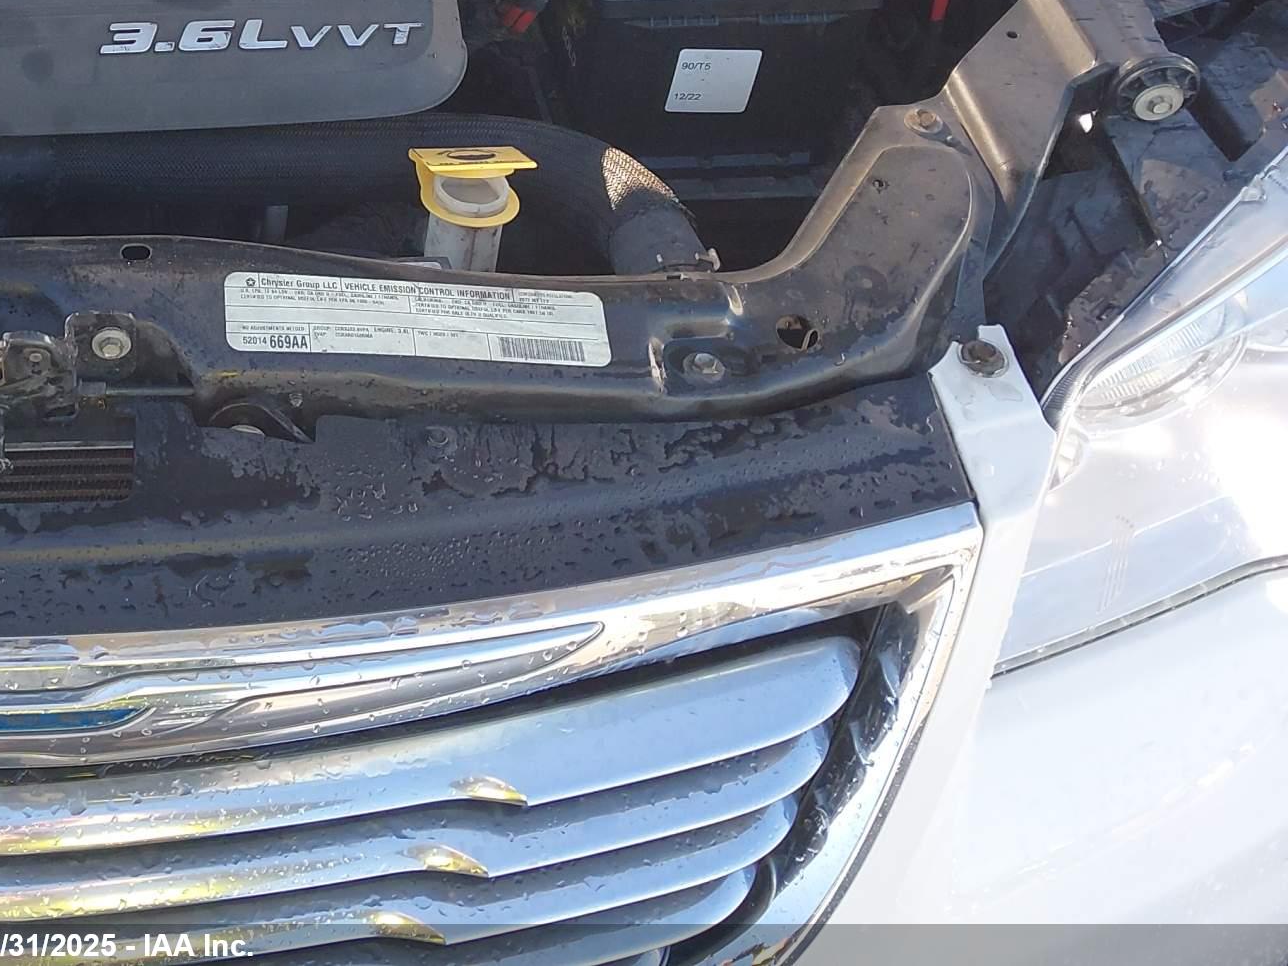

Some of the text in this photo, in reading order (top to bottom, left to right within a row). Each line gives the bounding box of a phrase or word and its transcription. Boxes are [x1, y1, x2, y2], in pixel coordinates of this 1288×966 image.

[681, 62, 711, 70] 90/T5
[674, 93, 702, 101] 12/22
[261, 277, 338, 290] Chrysler Group LLC
[344, 282, 376, 292] VEHICLE
[378, 283, 416, 294] EMISSION
[418, 287, 454, 297] CONTROL
[456, 289, 510, 300] INFORMATION
[242, 335, 308, 350] 52014 669AA
